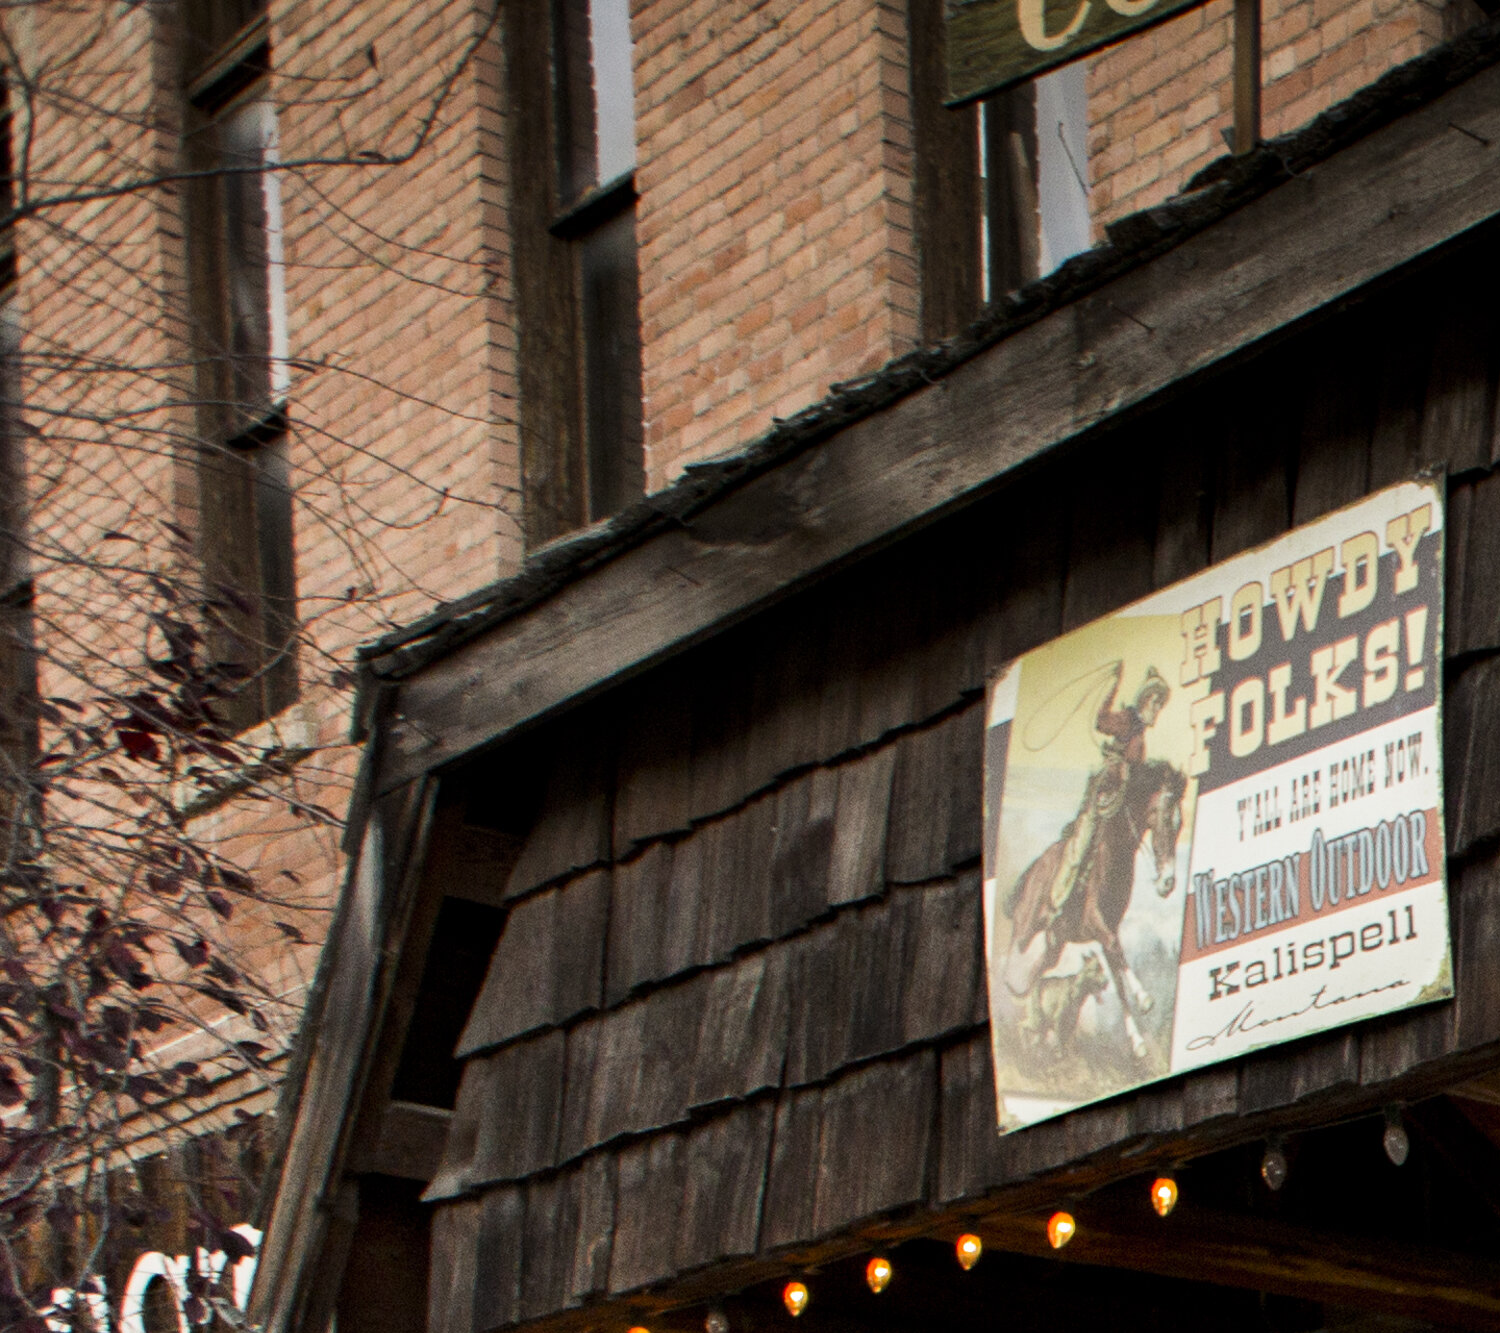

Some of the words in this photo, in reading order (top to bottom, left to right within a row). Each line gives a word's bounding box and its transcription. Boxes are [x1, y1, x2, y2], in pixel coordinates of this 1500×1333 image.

[1180, 502, 1432, 688] HOWDY
[1189, 604, 1429, 777] FOLKS!
[1290, 769, 1322, 823] ARE
[1329, 748, 1376, 809] HOME
[1385, 731, 1429, 789] NOW.
[1193, 851, 1301, 950] WESTERN
[1309, 808, 1429, 913] OUTDOOR
[1208, 904, 1418, 1001] Kalispell
[1185, 977, 1411, 1051] Montana
